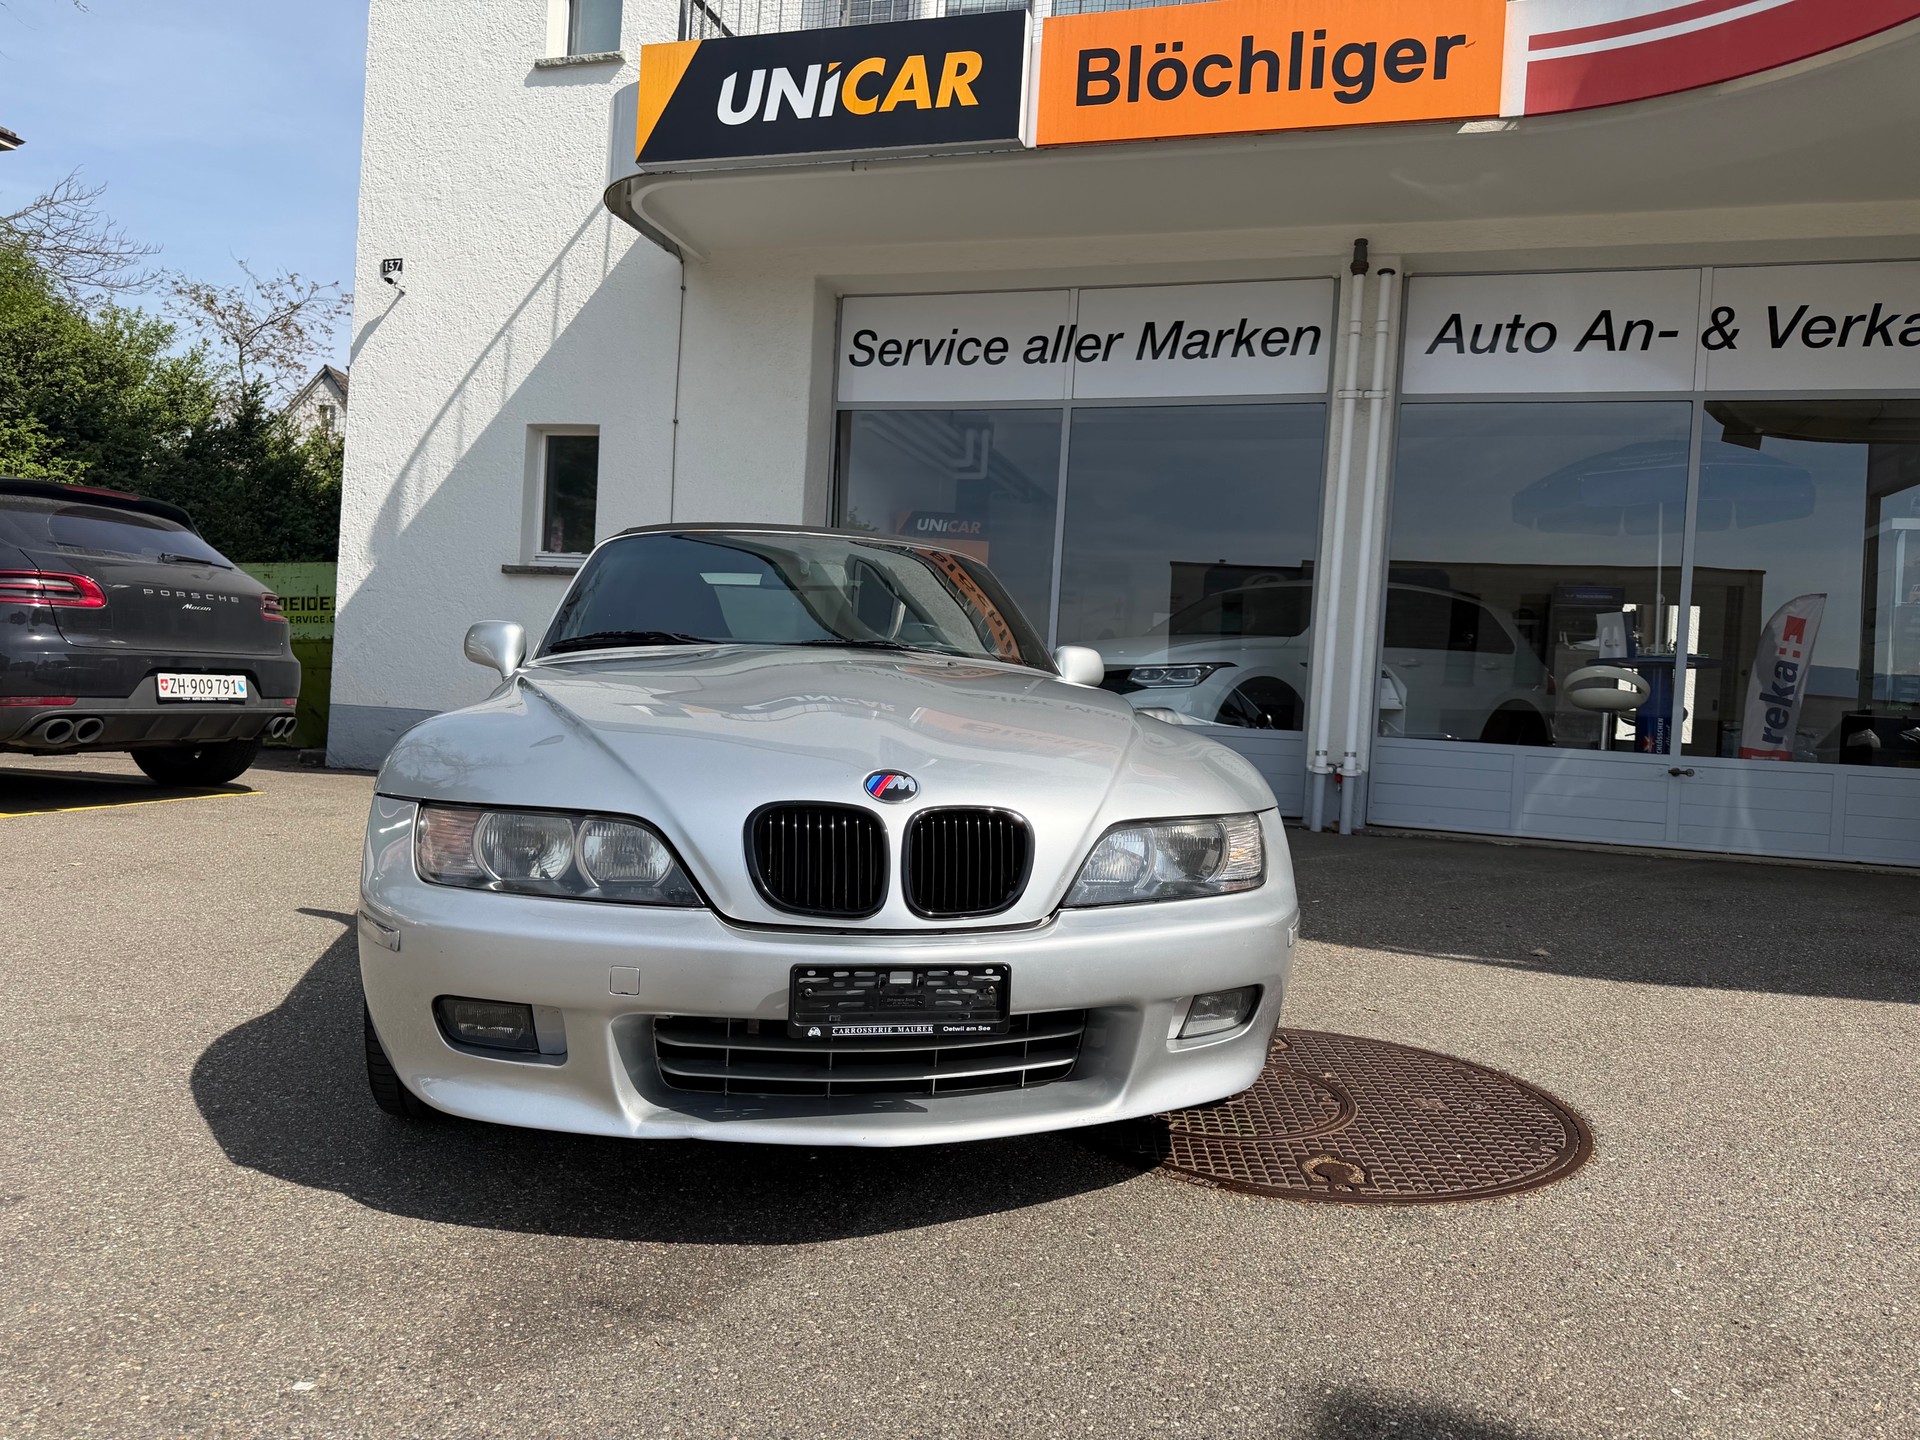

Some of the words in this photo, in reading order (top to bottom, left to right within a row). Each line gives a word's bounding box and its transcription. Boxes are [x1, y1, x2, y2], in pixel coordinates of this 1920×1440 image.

[1075, 29, 1467, 107] Blöchliger
[384, 260, 401, 272] 137
[1425, 313, 1558, 355] Auto
[1575, 309, 1679, 353] An-
[1701, 306, 1740, 351] &
[849, 328, 1009, 368] Service
[1023, 324, 1124, 366] aller
[1136, 317, 1323, 361] Marken
[143, 588, 240, 603] PORSCHE
[182, 603, 212, 611] Macan
[832, 1027, 893, 1035] CARROSSERIE
